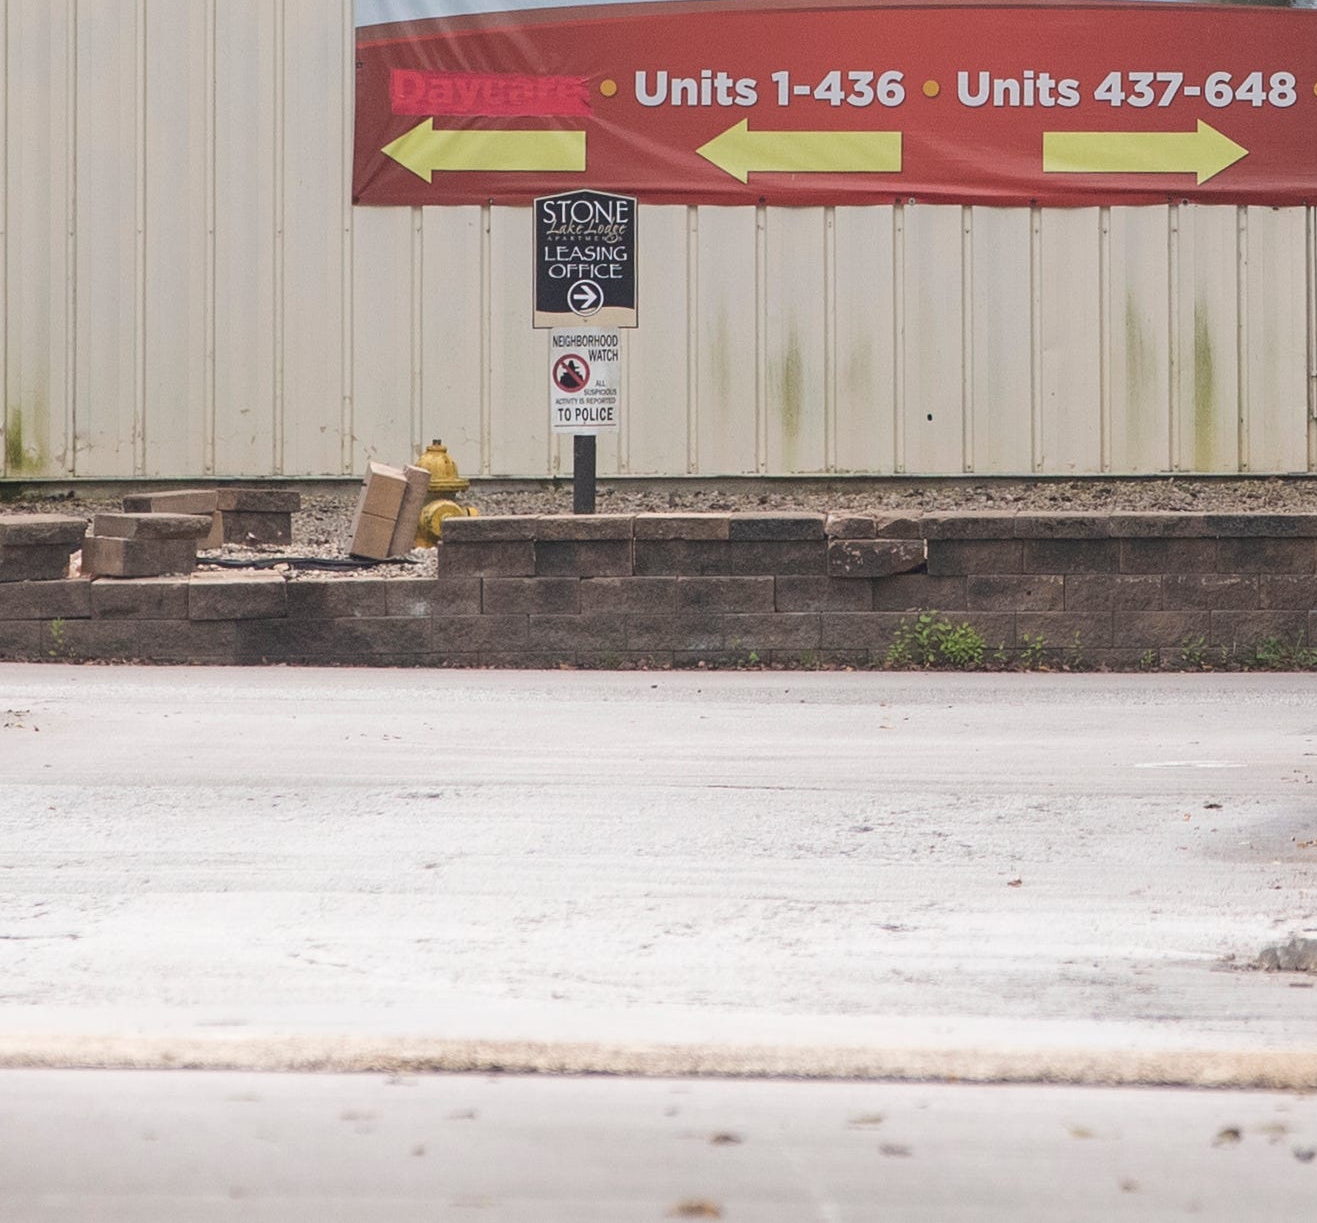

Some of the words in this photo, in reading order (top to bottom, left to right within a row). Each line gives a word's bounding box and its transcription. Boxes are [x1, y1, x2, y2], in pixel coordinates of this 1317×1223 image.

[634, 70, 758, 107] Units
[772, 70, 905, 108] 1-436
[956, 70, 1080, 107] Units
[1093, 70, 1297, 108] 437-648
[543, 200, 629, 224] STONE
[546, 218, 584, 235] Lake
[583, 216, 627, 244] Lodge
[544, 245, 628, 262] LEASING
[548, 263, 623, 279] OFFICE
[552, 334, 619, 348] NEIGHBORHOOD
[588, 349, 619, 362] WATCH
[595, 379, 606, 387] ALL
[555, 397, 578, 405] ACTIVITY
[586, 396, 616, 405] REPORTED
[558, 408, 571, 421] TO
[575, 406, 614, 422] POLICE
